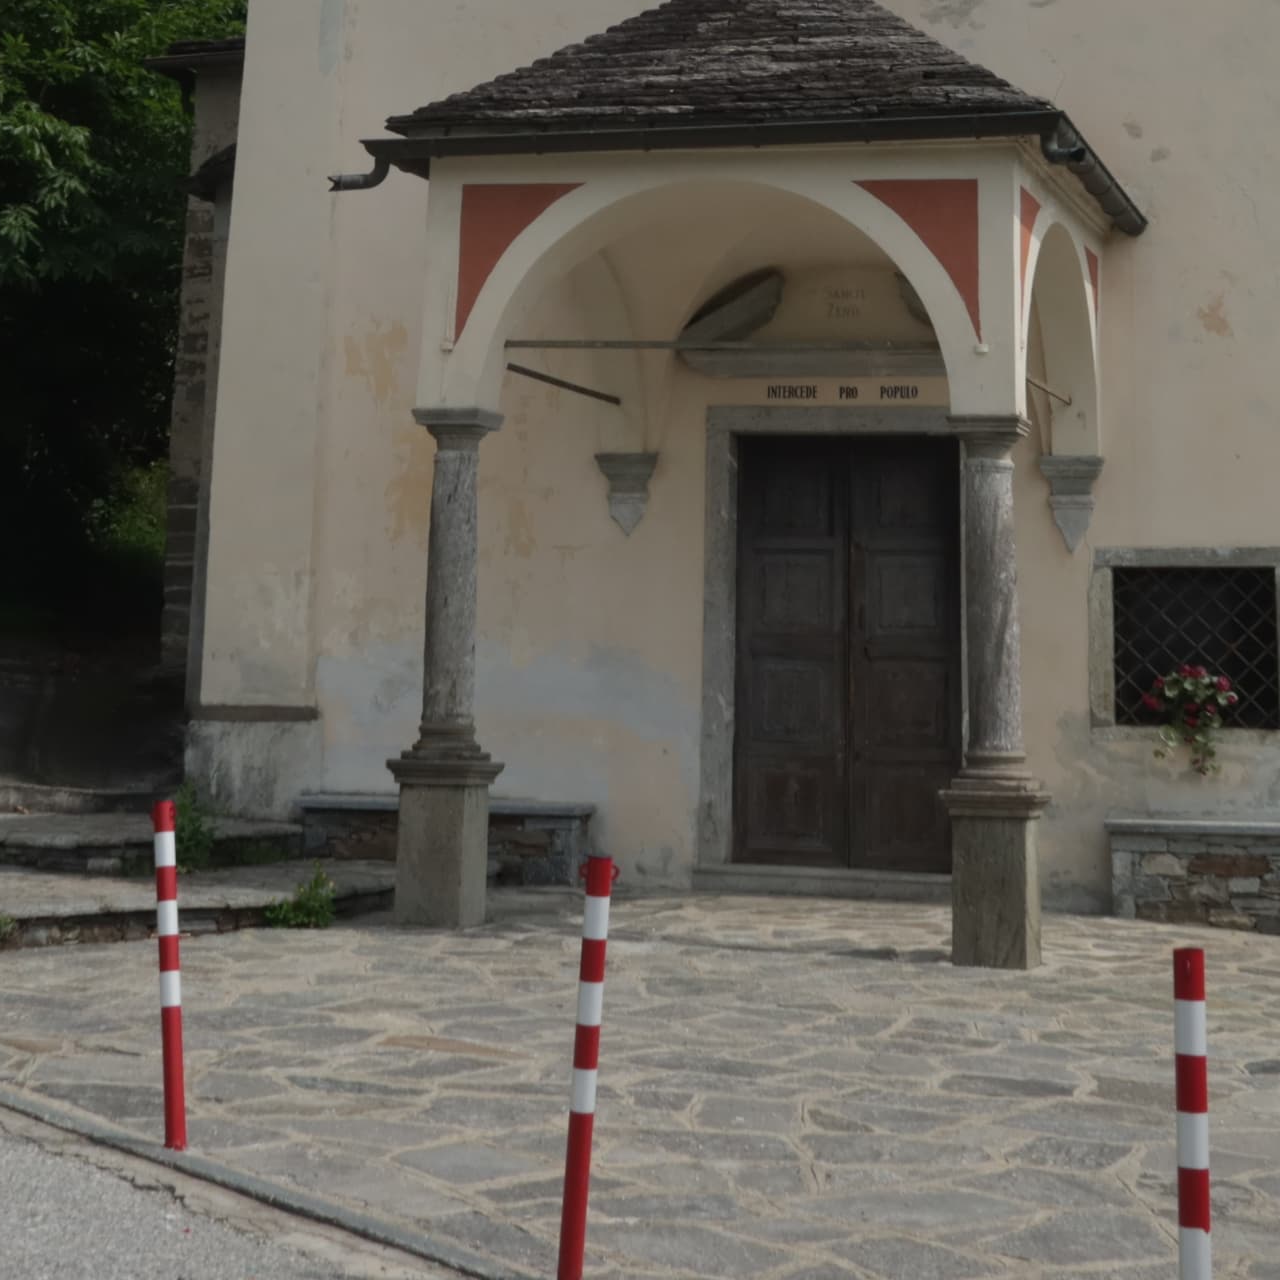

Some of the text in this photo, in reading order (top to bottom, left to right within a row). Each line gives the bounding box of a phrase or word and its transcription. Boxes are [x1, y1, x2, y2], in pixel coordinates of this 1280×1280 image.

[767, 384, 919, 400] INTERCEDE PRO POPULO
